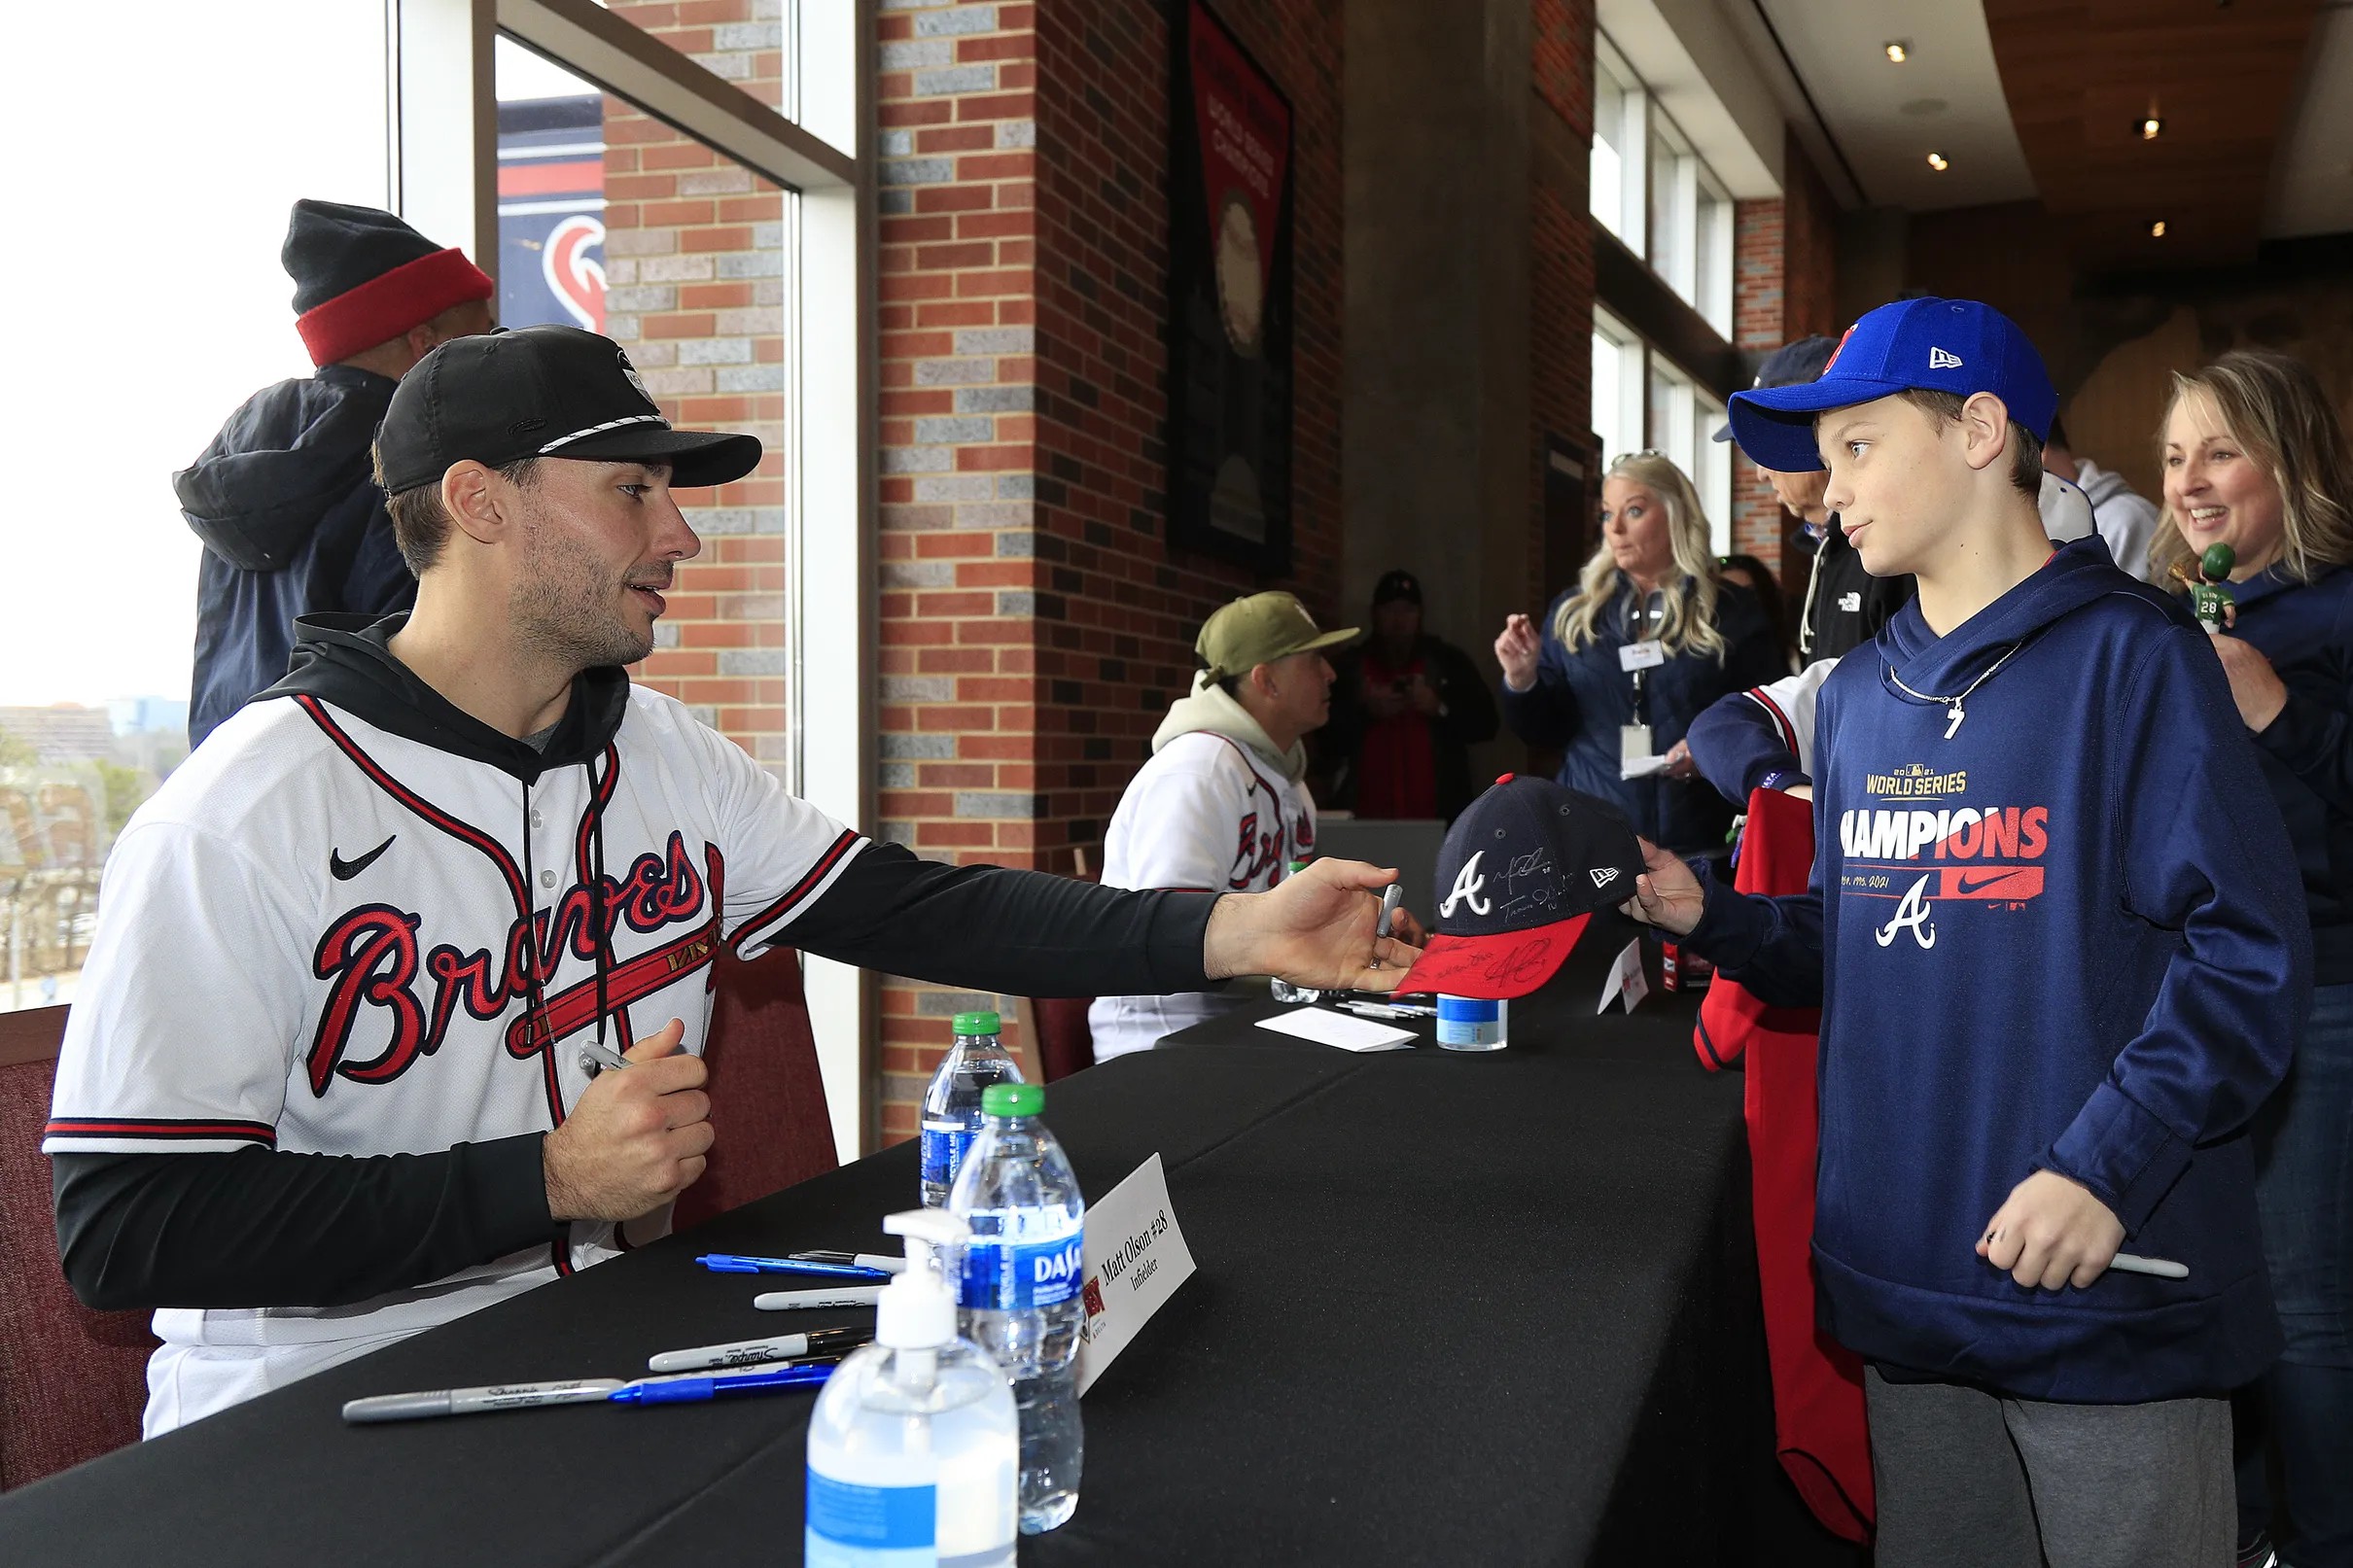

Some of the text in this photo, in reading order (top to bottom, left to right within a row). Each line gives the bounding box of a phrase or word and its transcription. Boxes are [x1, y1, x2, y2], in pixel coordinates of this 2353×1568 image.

[2200, 601, 2217, 614] 28
[1866, 771, 1966, 795] WORLD SERIES
[1439, 850, 1492, 919] A
[1868, 875, 1890, 889] 2021
[1875, 873, 1937, 950] A
[307, 830, 704, 1098] Braves
[1101, 1209, 1169, 1287] Matt Olson #28
[1130, 1259, 1159, 1291] Infielder
